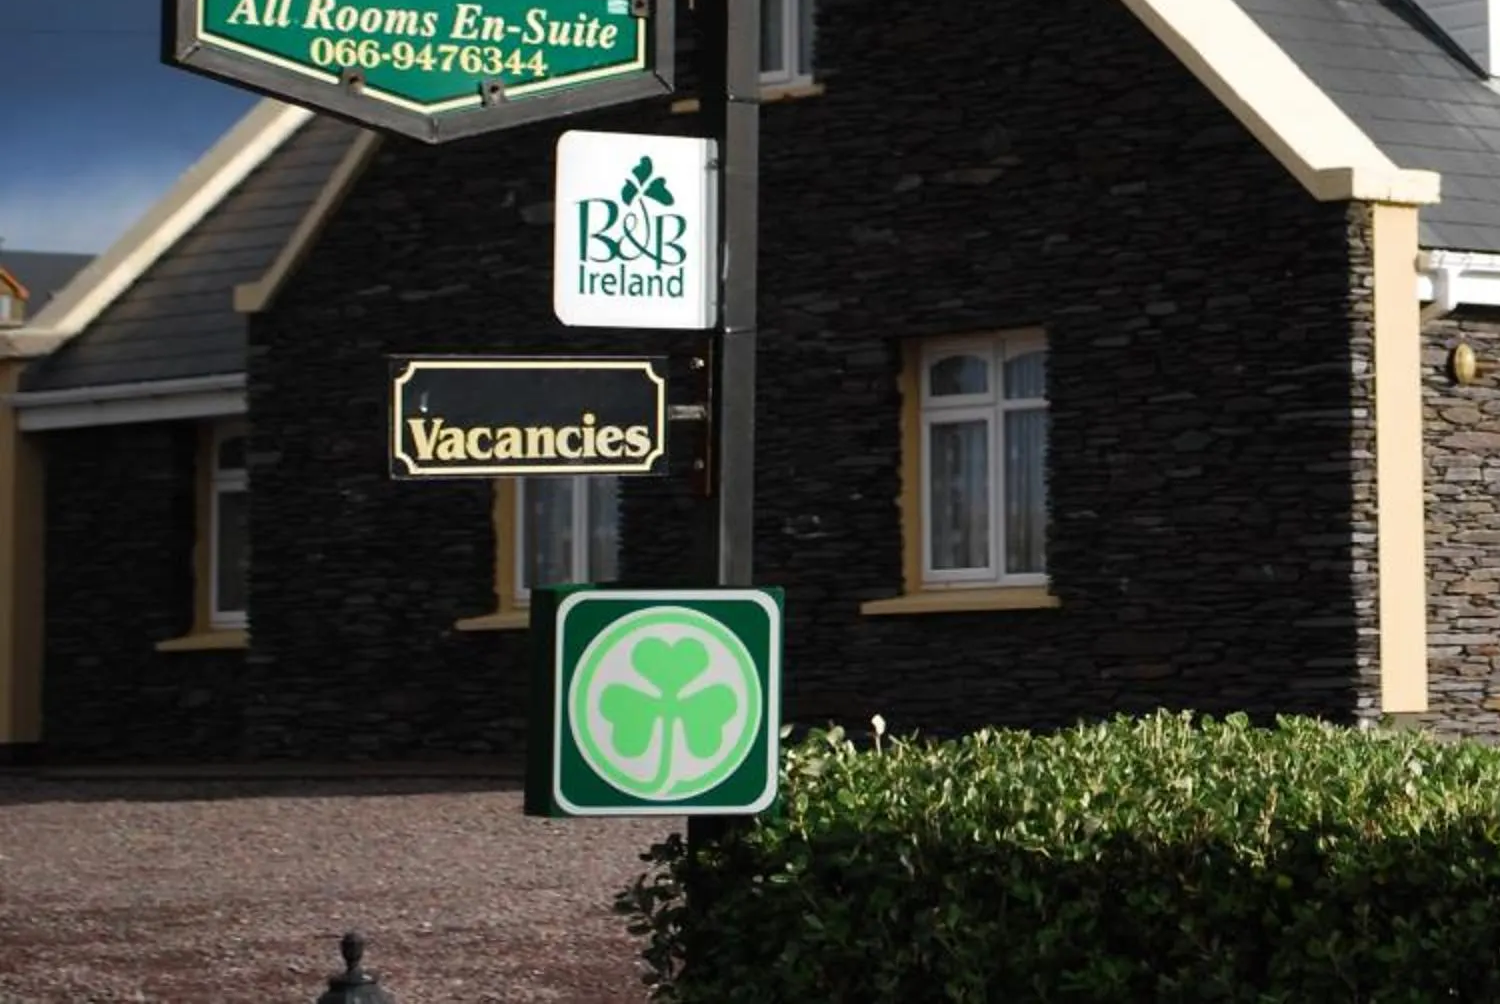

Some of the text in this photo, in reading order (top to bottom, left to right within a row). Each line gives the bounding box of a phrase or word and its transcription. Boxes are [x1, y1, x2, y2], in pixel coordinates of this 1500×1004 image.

[450, 3, 619, 49] En-Suite
[310, 36, 549, 77] 066-9476344
[574, 197, 688, 269] B&B
[578, 264, 685, 298] Ireland
[406, 413, 652, 461] Vacancies
